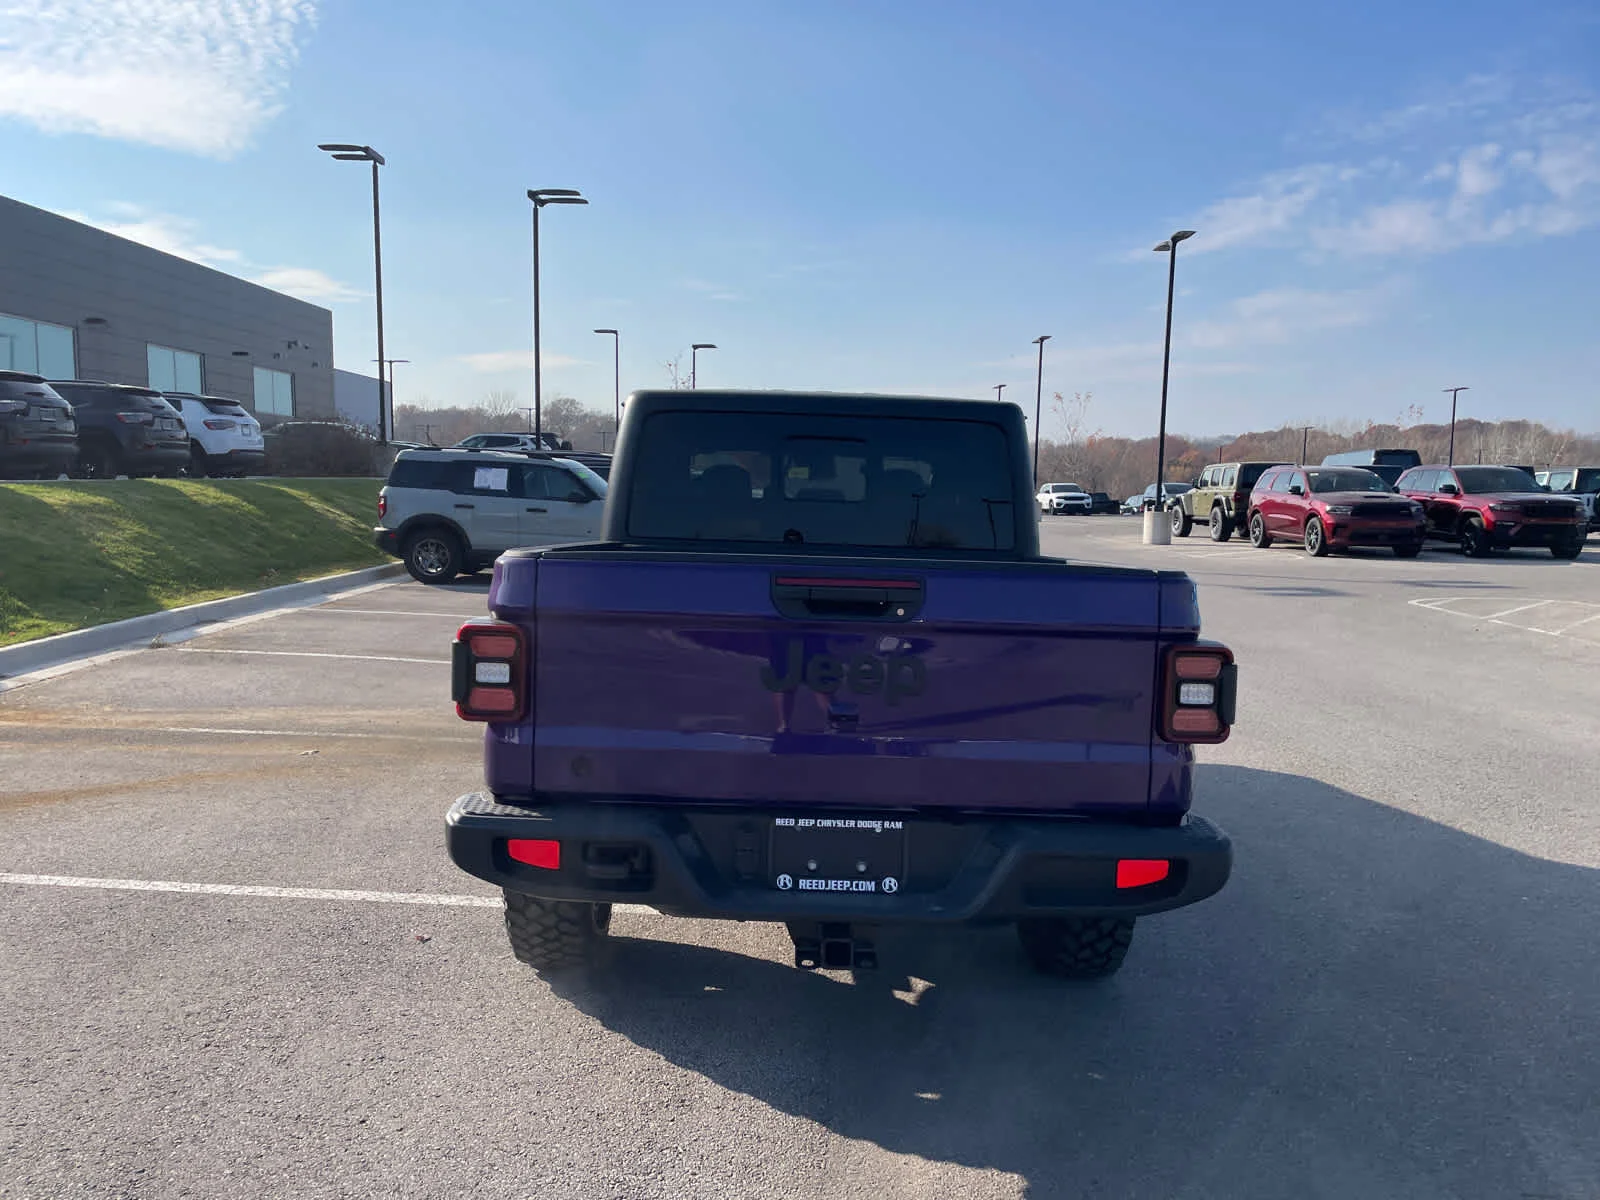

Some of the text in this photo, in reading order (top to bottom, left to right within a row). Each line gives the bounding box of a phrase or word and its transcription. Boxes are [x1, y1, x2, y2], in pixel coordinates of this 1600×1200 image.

[760, 637, 927, 706] Jeep
[775, 818, 904, 830] REED JEEP CHRYSLER DODGE RAM
[798, 878, 876, 892] REEDJEEP.COM
